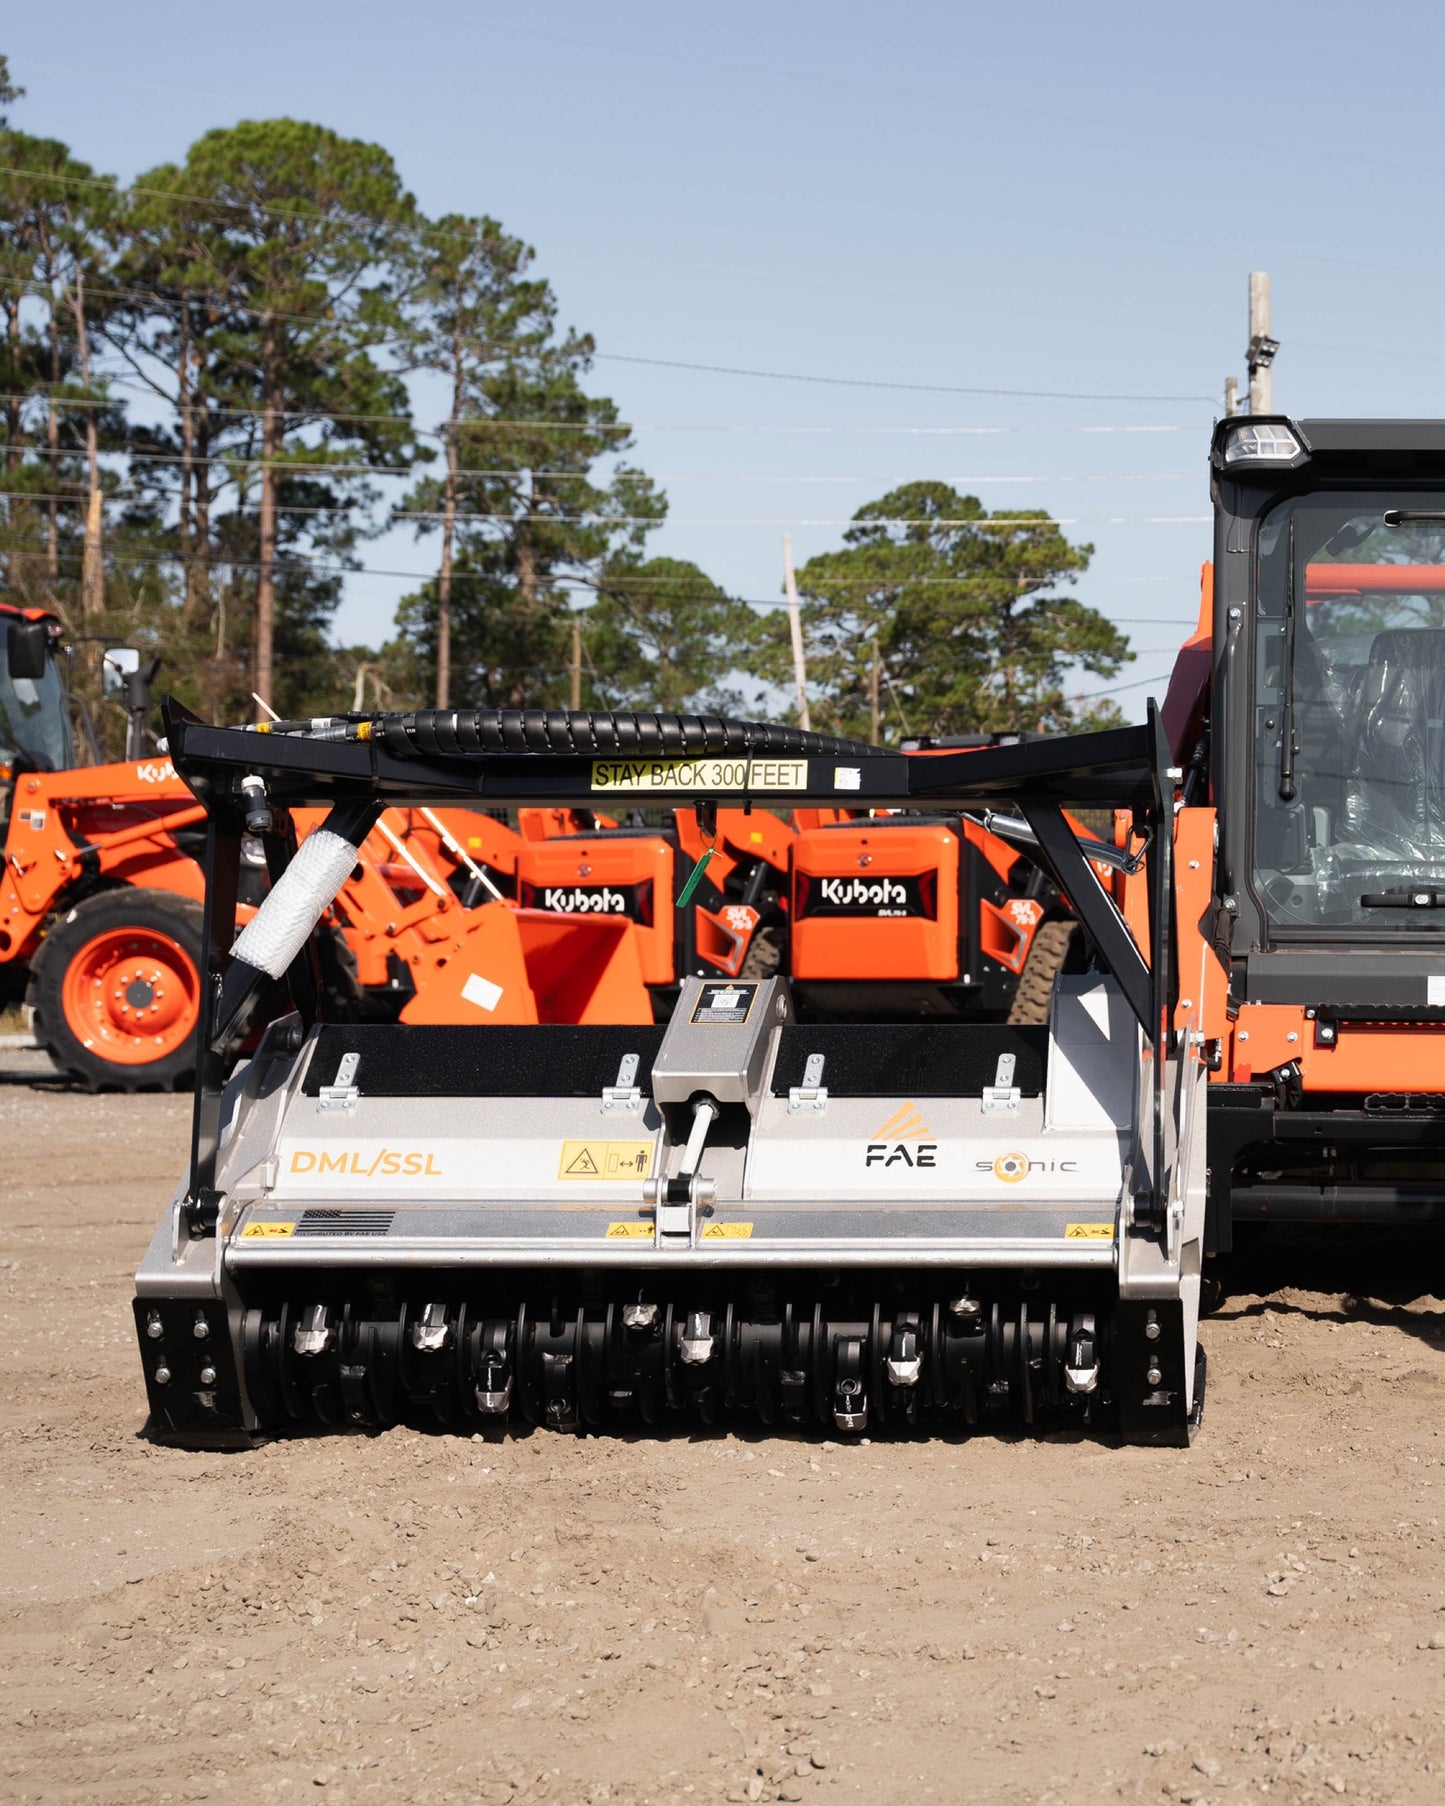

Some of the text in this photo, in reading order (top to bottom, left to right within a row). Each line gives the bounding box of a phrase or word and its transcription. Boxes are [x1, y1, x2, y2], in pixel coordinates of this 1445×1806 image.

[595, 764, 803, 787] STAY BACK 300 FEET
[545, 887, 625, 913] Kubota
[821, 878, 907, 905] Kubota
[1010, 902, 1034, 915] SVL
[290, 1148, 443, 1177] DML/SSL
[865, 1144, 938, 1168] FAE
